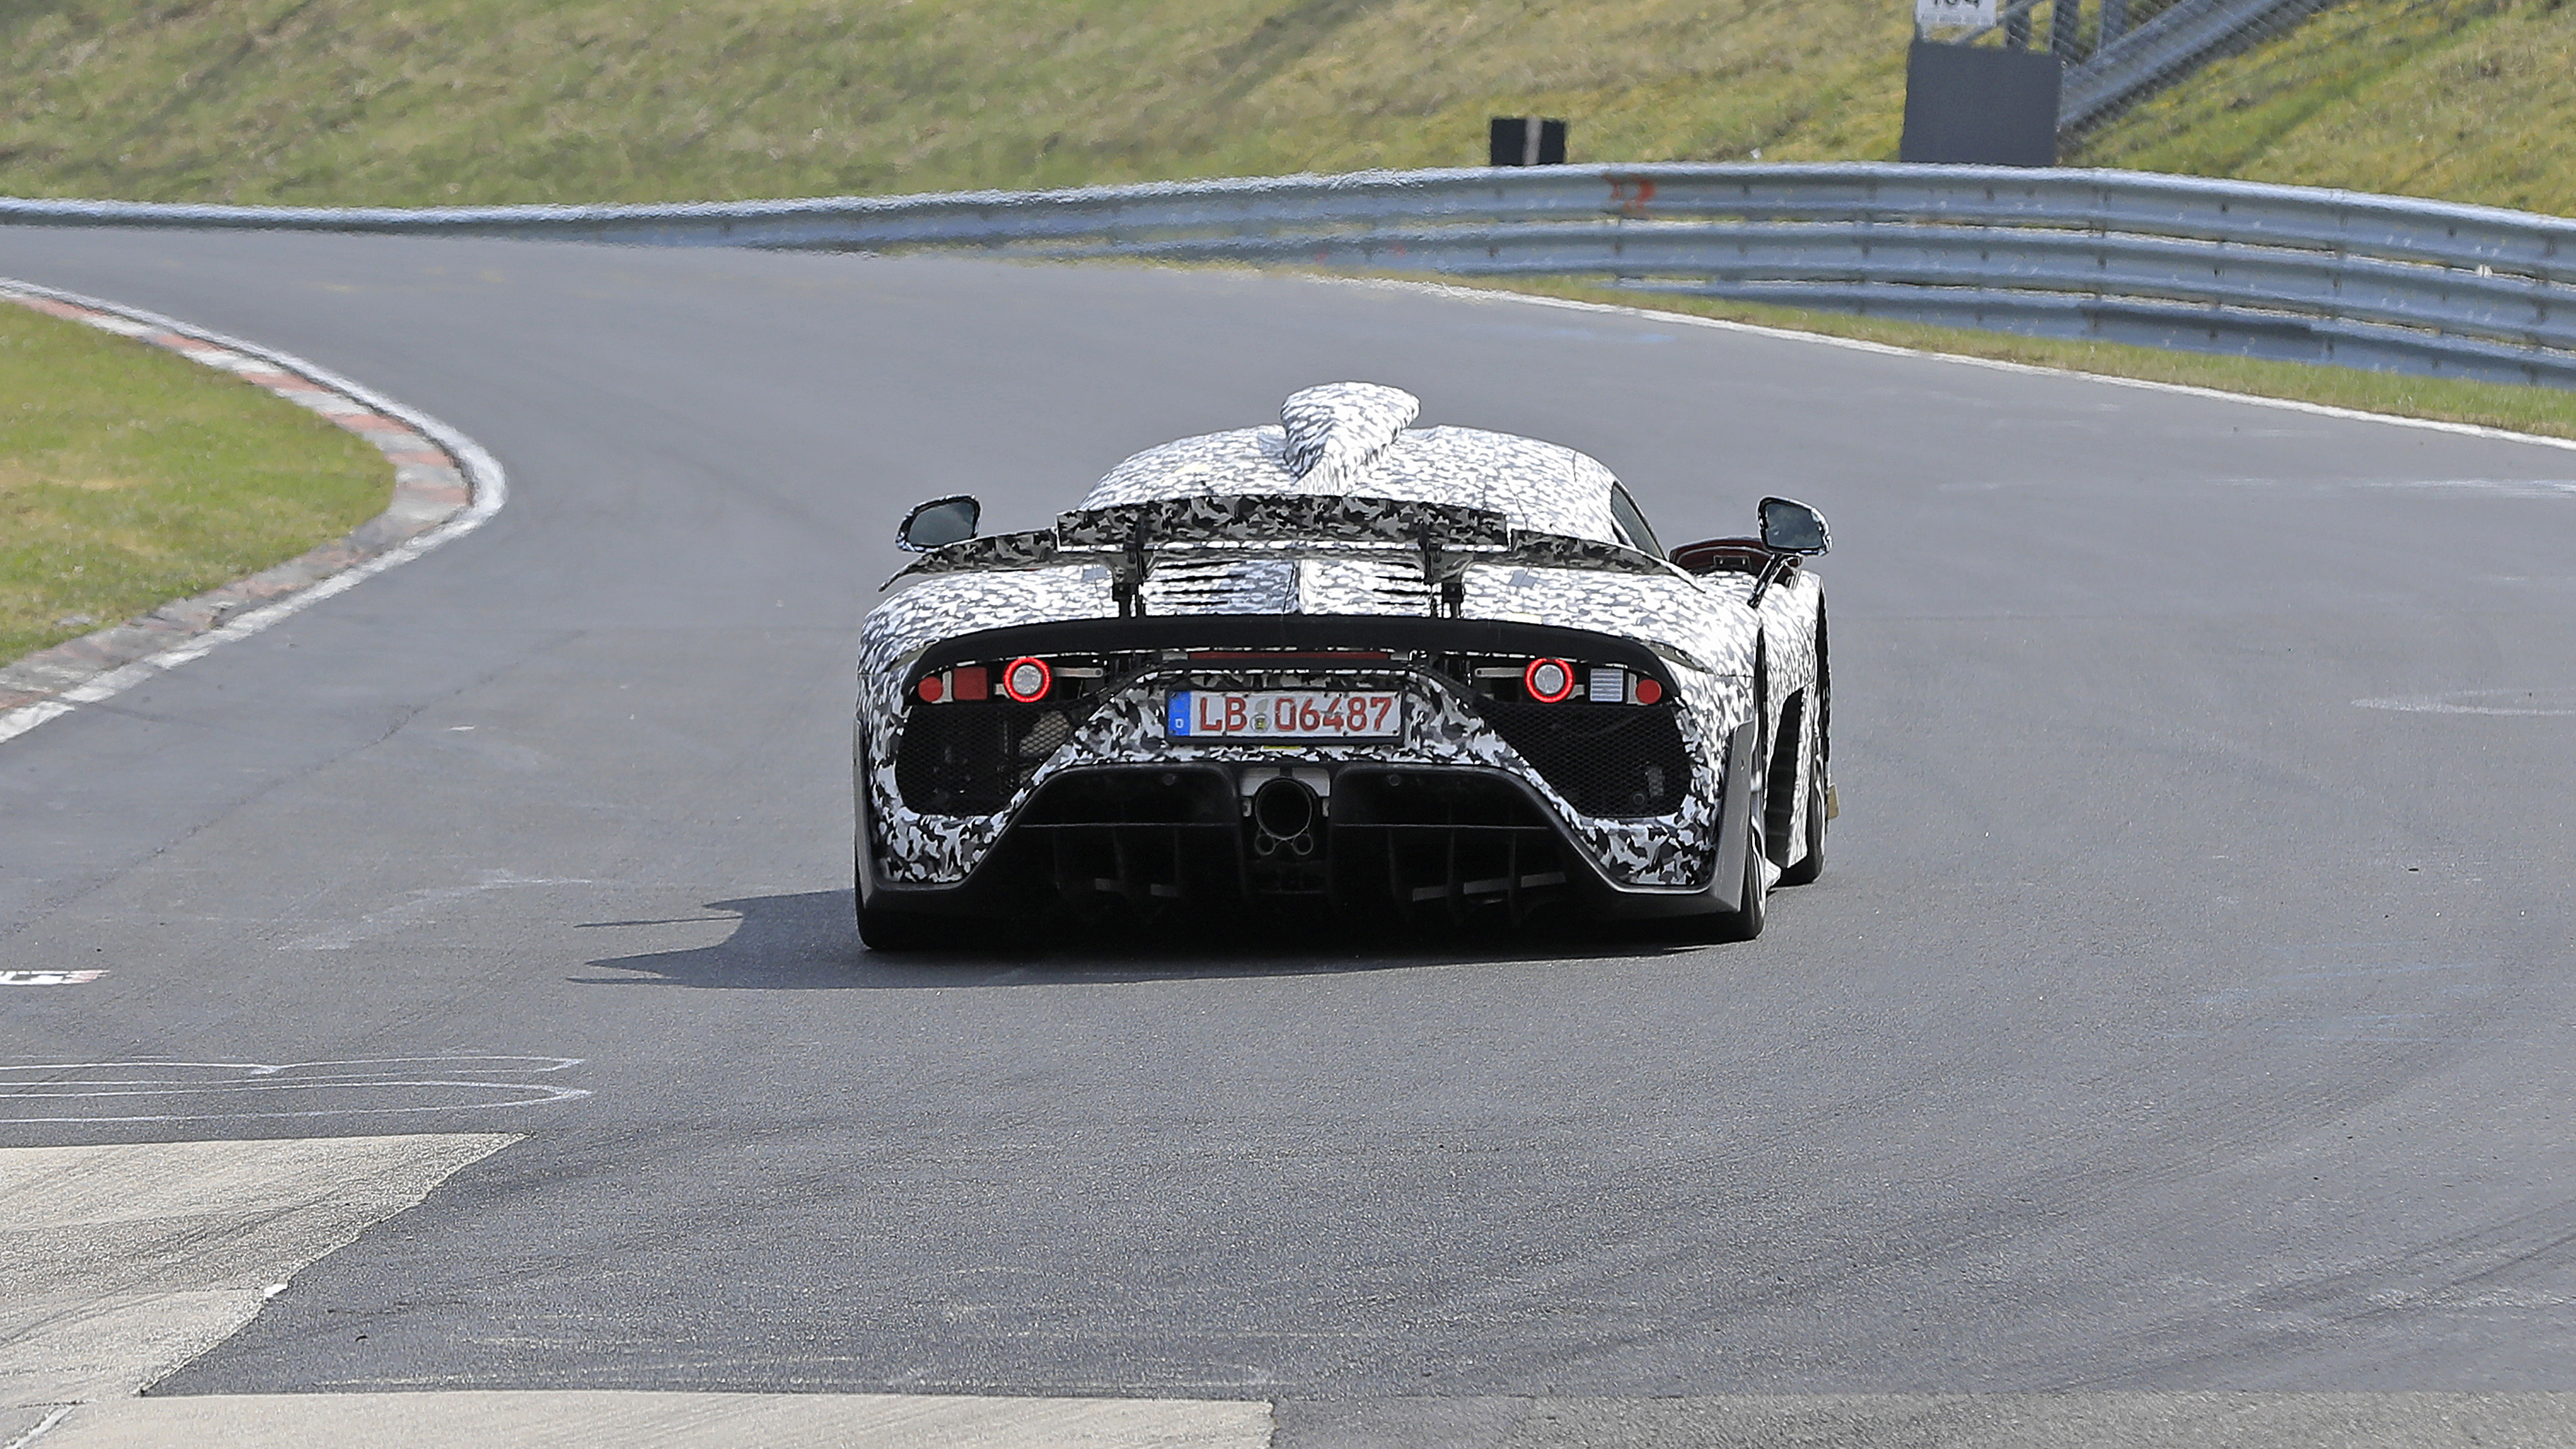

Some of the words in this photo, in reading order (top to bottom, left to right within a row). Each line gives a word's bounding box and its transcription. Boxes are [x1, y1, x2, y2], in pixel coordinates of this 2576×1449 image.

[1176, 718, 1184, 729] D
[1200, 697, 1248, 731] LB
[1275, 697, 1392, 731] 06487
